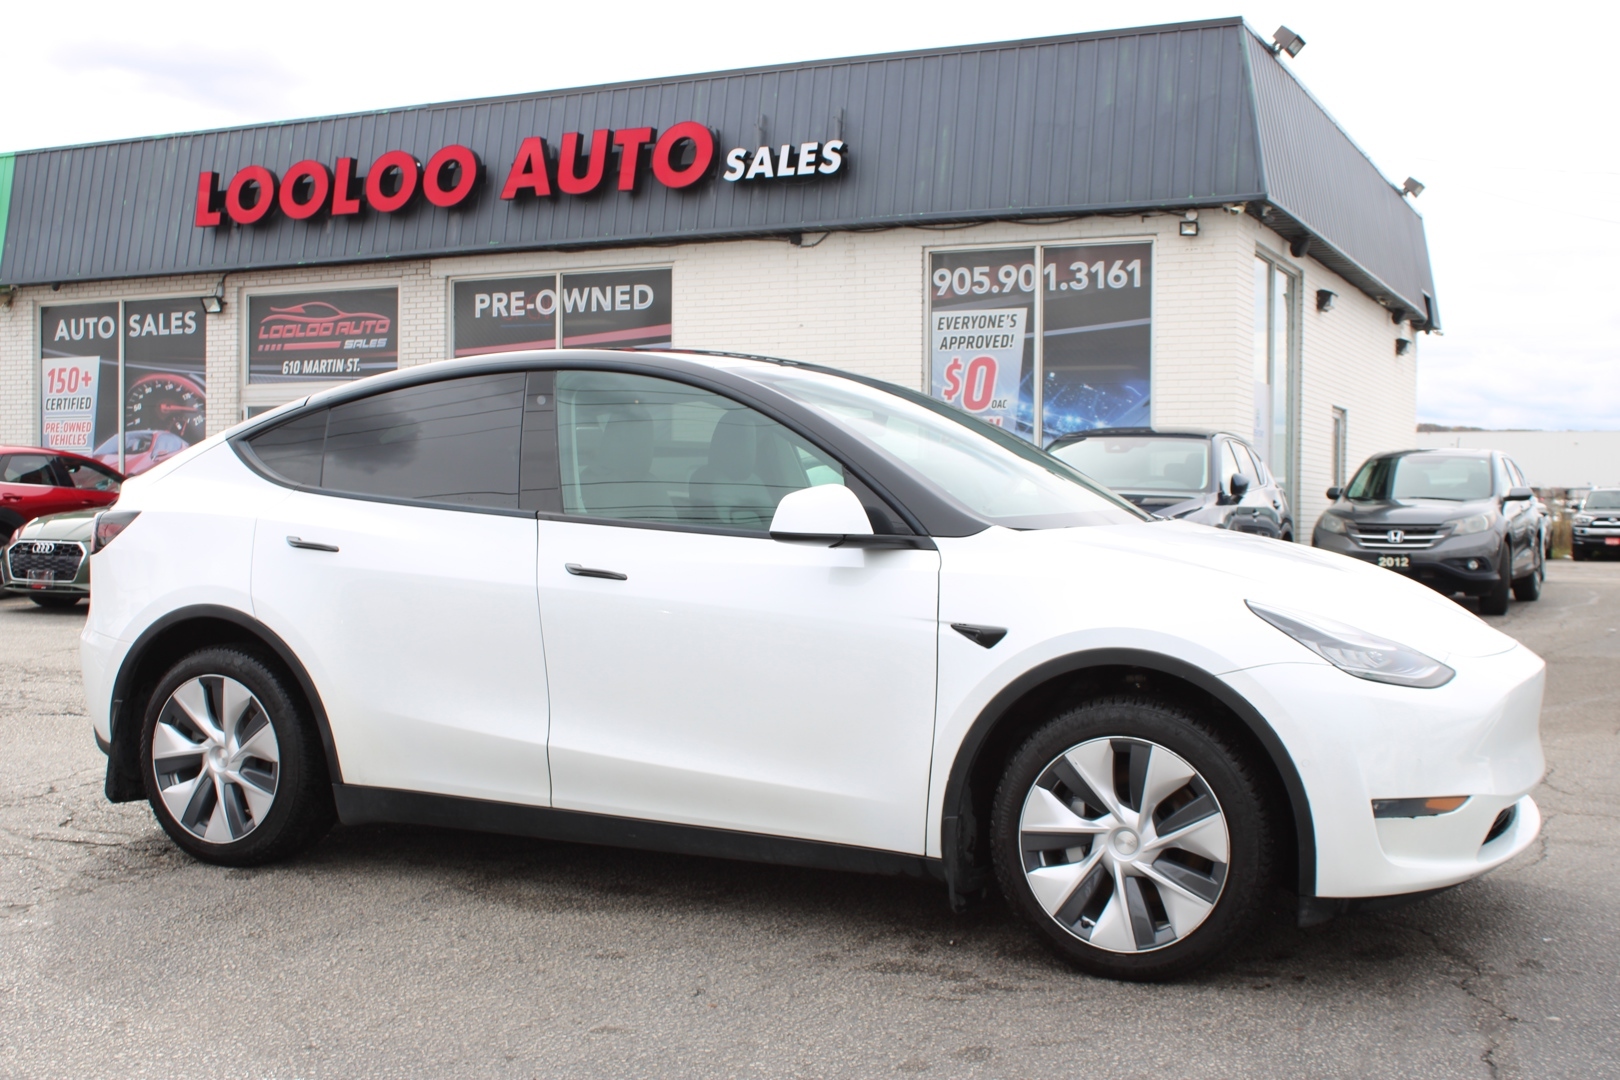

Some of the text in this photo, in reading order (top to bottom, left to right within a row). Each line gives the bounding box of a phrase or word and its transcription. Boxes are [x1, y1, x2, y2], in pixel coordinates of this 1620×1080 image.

[195, 121, 845, 228] LOOLOO AUTO SALES
[933, 259, 1142, 296] 905.901.3161
[475, 284, 654, 318] PRE-OWNED
[54, 311, 196, 342] AUTO SALES
[258, 319, 391, 339] LOOLOO AUTO
[937, 314, 1018, 331] EVERYONE'S
[343, 338, 388, 350] SALES
[939, 334, 1014, 350] APPROVED!
[282, 358, 361, 375] 610 MARTIN ST.
[47, 366, 92, 394] 150+
[943, 356, 997, 411] $0
[45, 396, 92, 411] CERTIFIED
[991, 400, 1008, 409] OAC
[50, 433, 87, 446] VEHICLES
[1378, 556, 1409, 568] 2012
